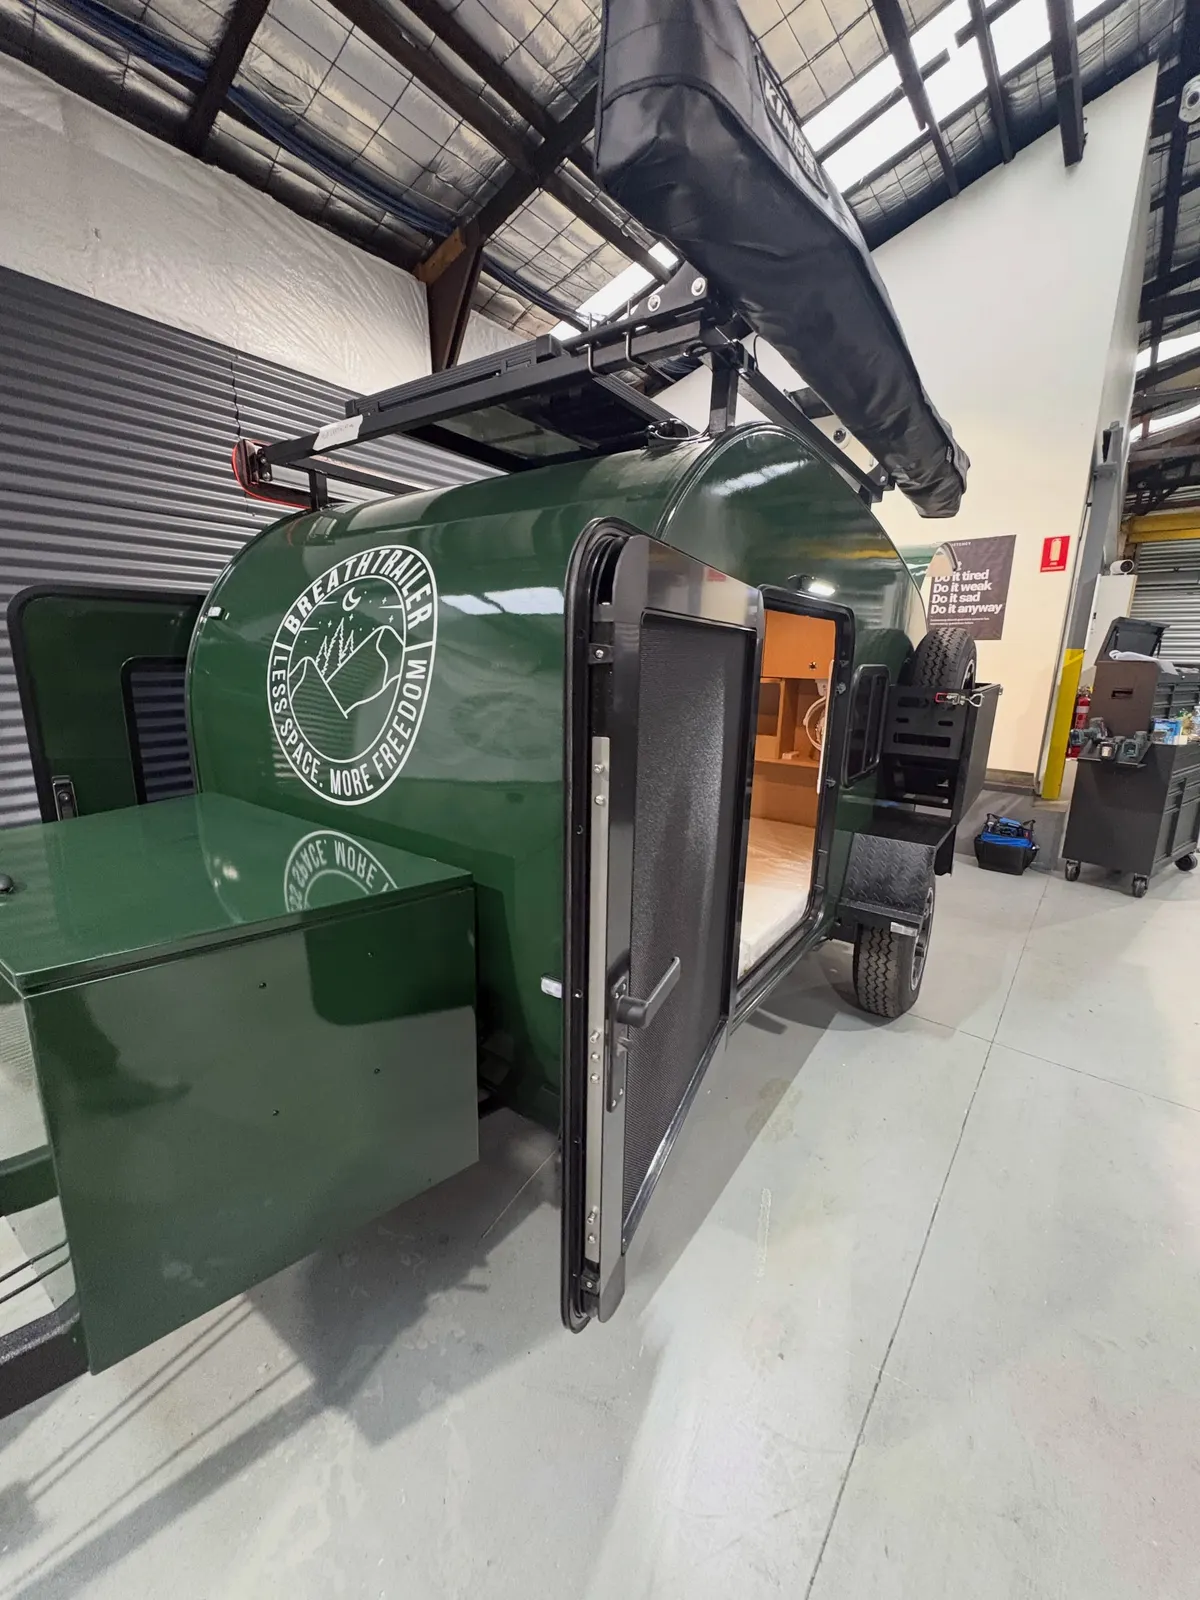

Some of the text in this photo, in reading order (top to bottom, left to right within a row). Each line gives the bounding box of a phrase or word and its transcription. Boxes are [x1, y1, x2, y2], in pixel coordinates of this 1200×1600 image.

[764, 78, 816, 173] KINGS
[952, 571, 961, 581] it
[962, 569, 990, 581] tired
[284, 549, 433, 630] BREATHTRAILER
[933, 580, 992, 593] Do it weak
[932, 592, 981, 604] Do it sad
[930, 603, 1003, 615] Do it anyway
[271, 654, 428, 796] LESS SPACE. MORE FREEDOM
